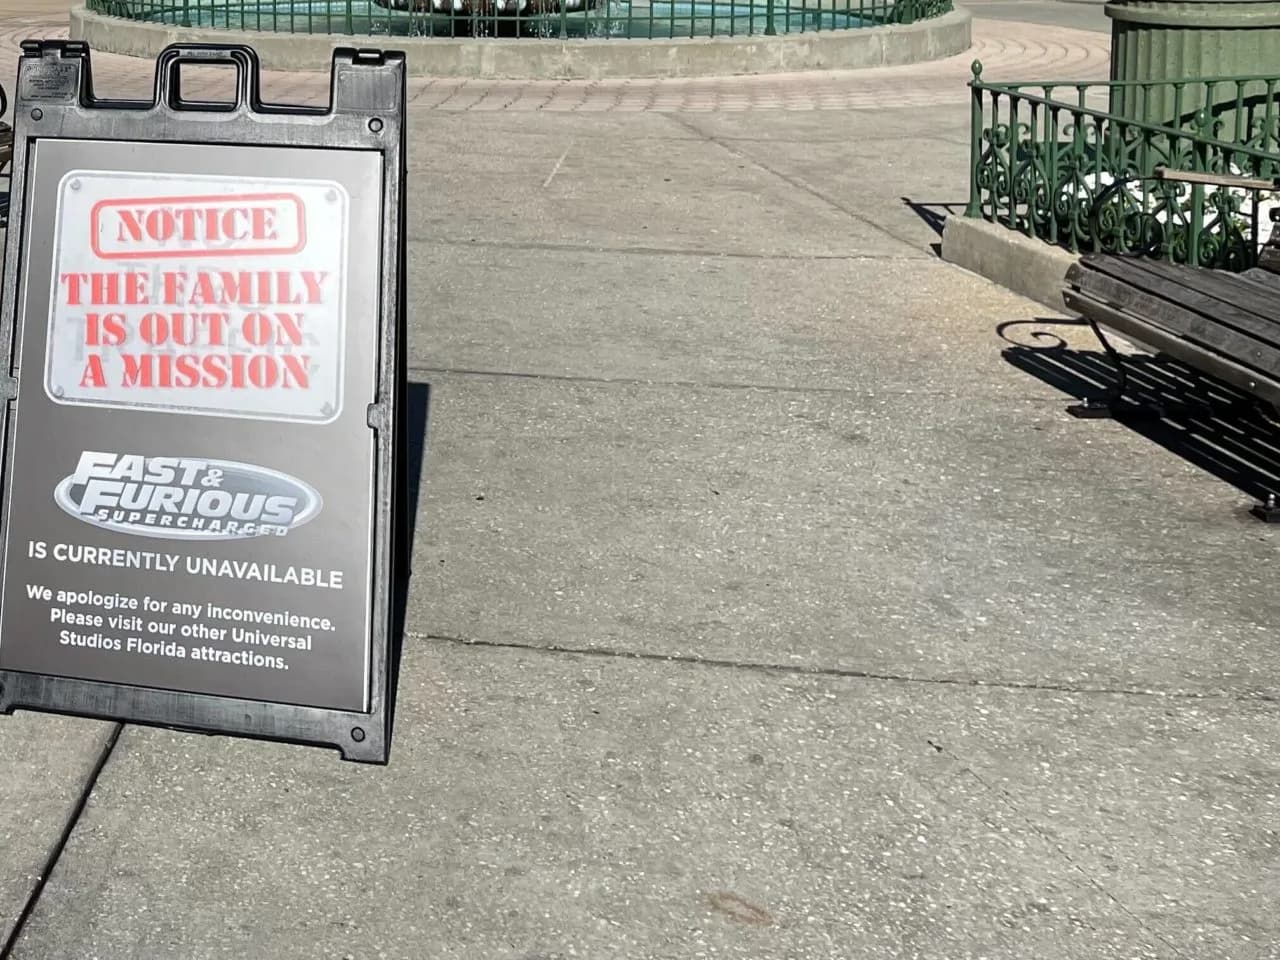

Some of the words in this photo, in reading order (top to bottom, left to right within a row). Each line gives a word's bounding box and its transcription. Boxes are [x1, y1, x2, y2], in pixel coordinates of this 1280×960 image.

[116, 207, 278, 242] NOTICE
[61, 272, 150, 305] THE
[162, 271, 329, 305] FAMILY
[85, 313, 127, 346] IS
[138, 313, 231, 346] OUT
[241, 312, 305, 346] ON
[79, 354, 108, 388] A
[120, 353, 311, 389] MISSION
[71, 450, 209, 487] FAST
[79, 479, 298, 525] FURIOUS
[96, 508, 289, 537] SUPERCHARGED
[28, 540, 48, 559] IS
[53, 543, 181, 572] CURRENTLY
[186, 556, 344, 589] UNAVAILABLE
[26, 584, 53, 601] We
[56, 590, 139, 609] apologize
[143, 596, 168, 612] for
[171, 602, 202, 619] any
[207, 603, 336, 632] inconvenience.
[50, 608, 104, 627] Please
[108, 615, 143, 631] visit
[147, 621, 177, 635] our
[180, 623, 227, 641] other
[232, 628, 312, 650] Universal
[59, 630, 122, 651] Studios
[126, 637, 186, 658] Florida
[190, 646, 289, 670] attractions.
